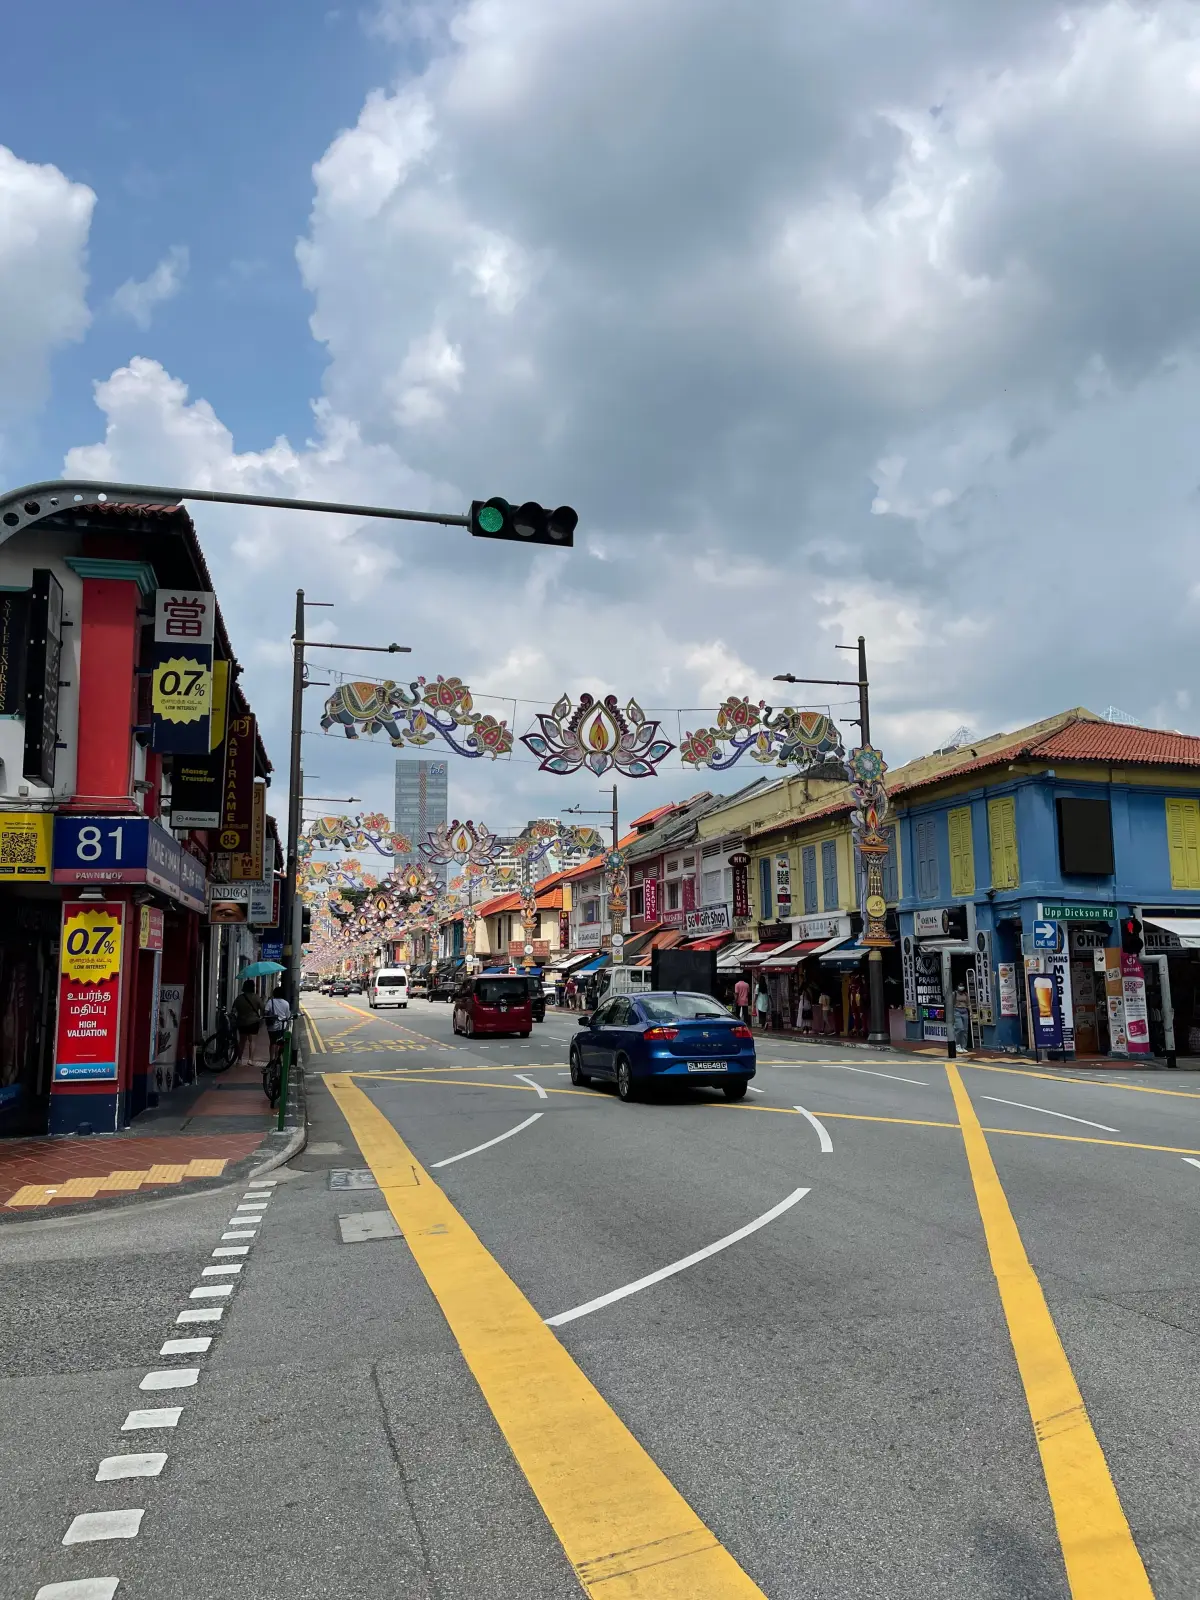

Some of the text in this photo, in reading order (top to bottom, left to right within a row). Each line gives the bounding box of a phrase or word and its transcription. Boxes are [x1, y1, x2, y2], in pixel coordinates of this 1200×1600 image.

[163, 596, 206, 636] 當
[0, 600, 12, 712] STYLE EXPRESS
[159, 670, 206, 697] 0.7%
[181, 767, 210, 776] Money
[181, 775, 216, 783] Transfer
[227, 737, 239, 822] ABIRAAME
[76, 826, 124, 861] 81
[223, 834, 237, 845] 85
[75, 872, 123, 880] PAWNSHOP
[687, 911, 725, 928] SG Gift Shop
[1044, 907, 1114, 918] Upp Dickson Rd
[66, 926, 117, 955] 0.7%
[976, 954, 984, 1003] OHMS
[982, 952, 990, 1003] MOBILE
[917, 985, 942, 995] MOBILE
[1053, 965, 1066, 1027] MOBILE
[78, 1020, 97, 1029] HIGH
[67, 1028, 107, 1038] VALUATION
[924, 1027, 940, 1037] MOBILE
[68, 1067, 107, 1075] MONEYMAX
